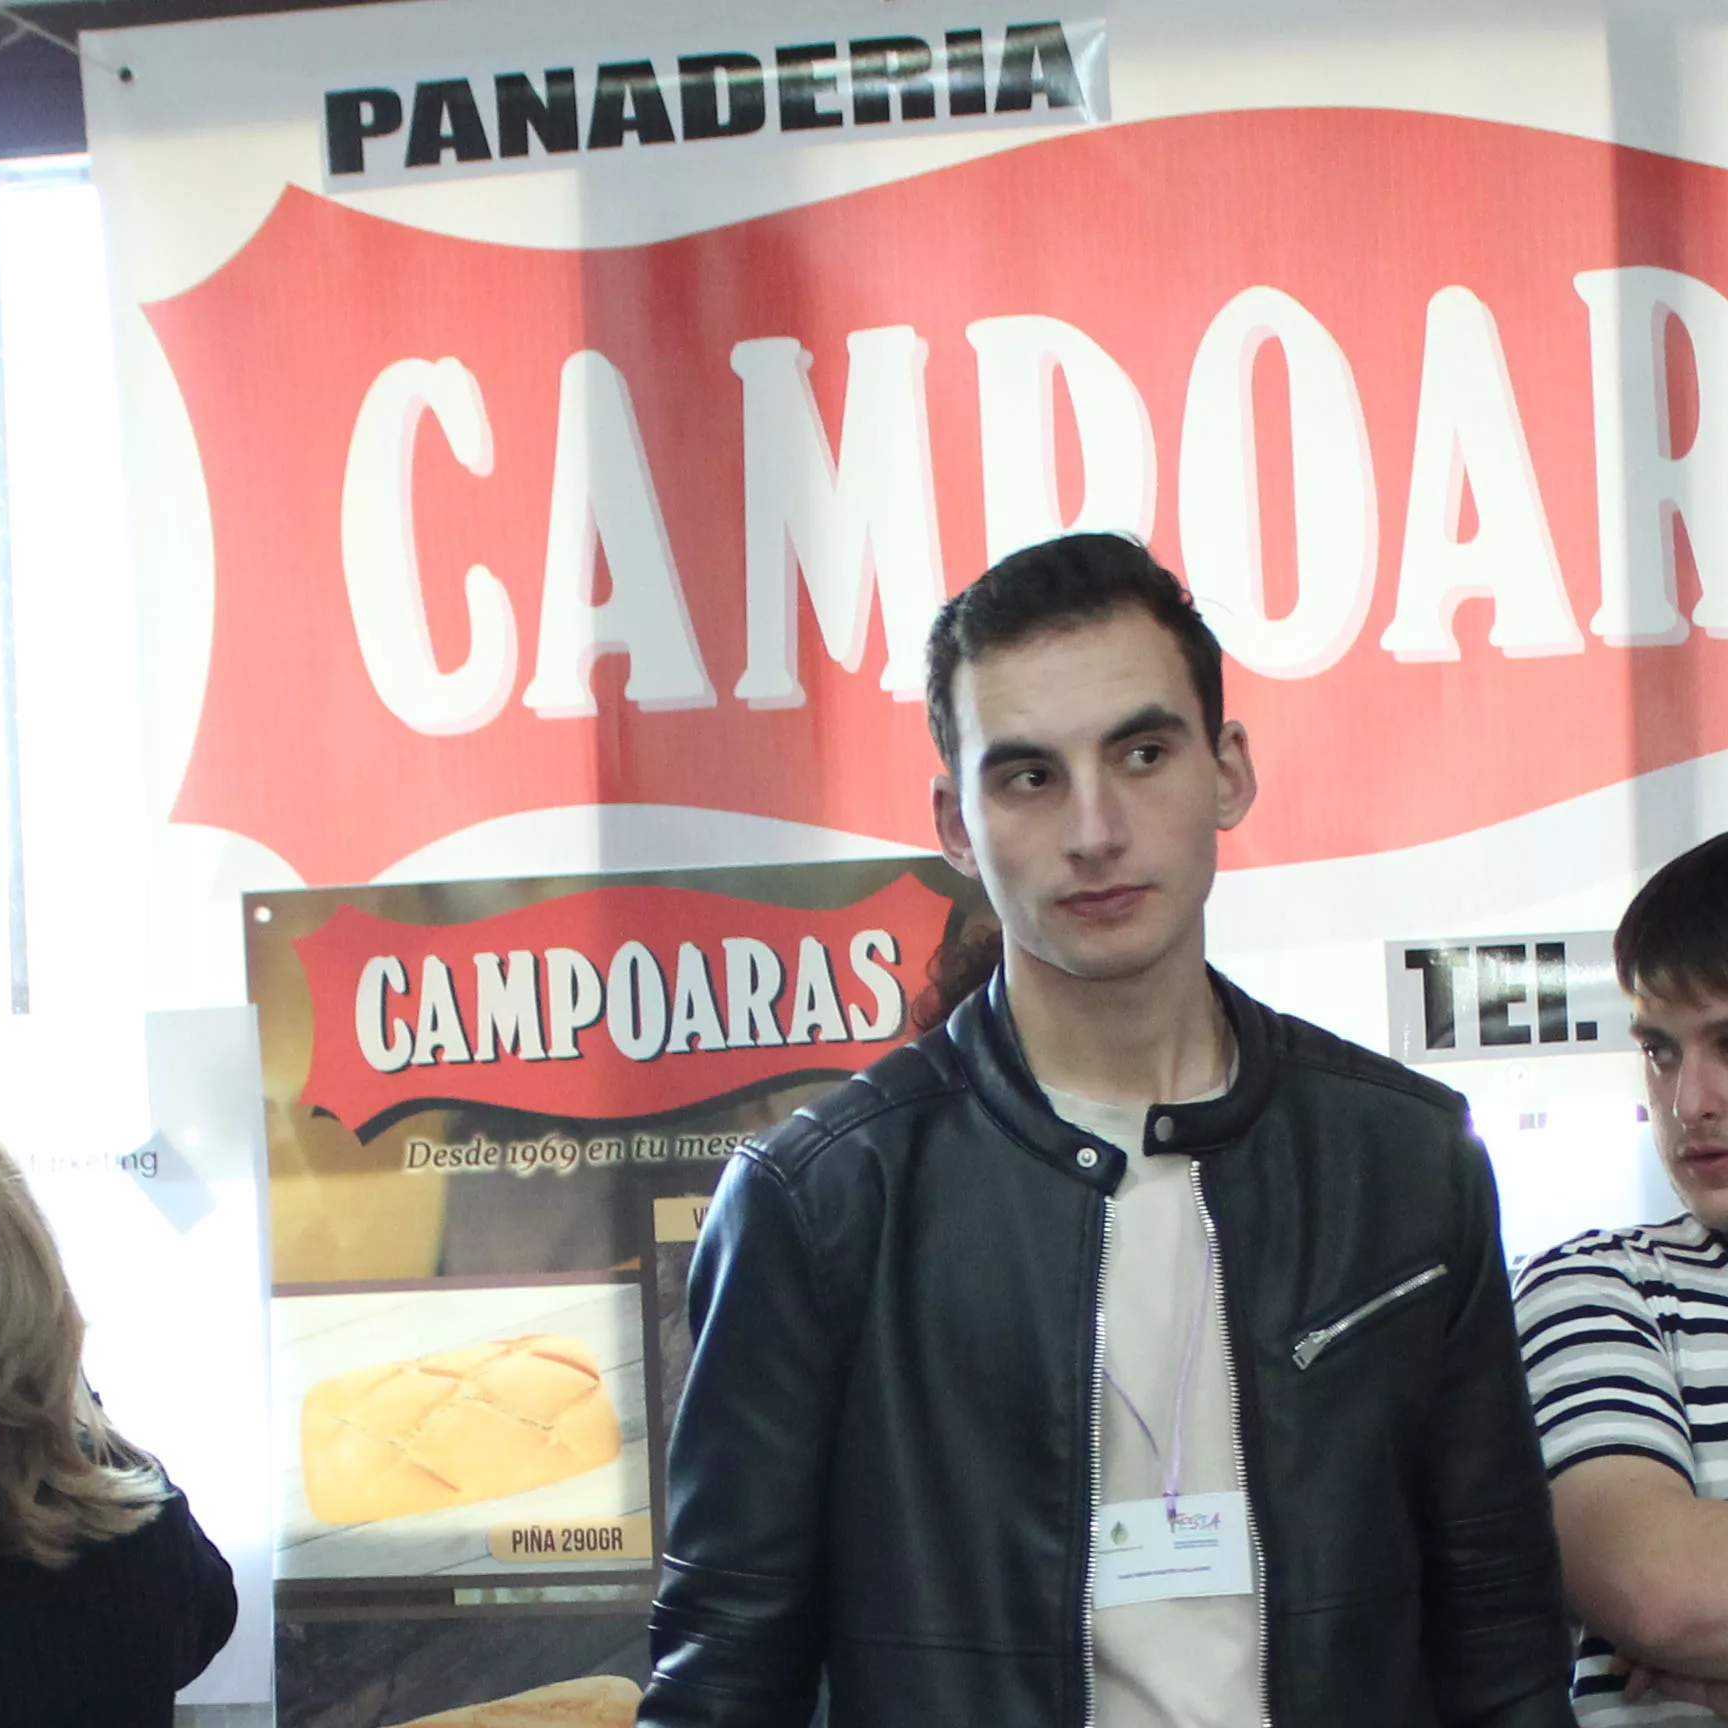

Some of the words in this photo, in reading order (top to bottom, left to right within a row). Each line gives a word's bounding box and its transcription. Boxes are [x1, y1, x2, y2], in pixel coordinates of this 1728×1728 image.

[321, 18, 1087, 176] PANADERIA
[355, 928, 906, 1074] CAMPOARAS
[406, 1137, 498, 1169] Desde
[507, 1134, 579, 1171] 1969
[587, 1138, 623, 1161] en
[635, 1137, 667, 1160] tu
[512, 1525, 555, 1553] PIÑA
[561, 1527, 623, 1551] 290GR
